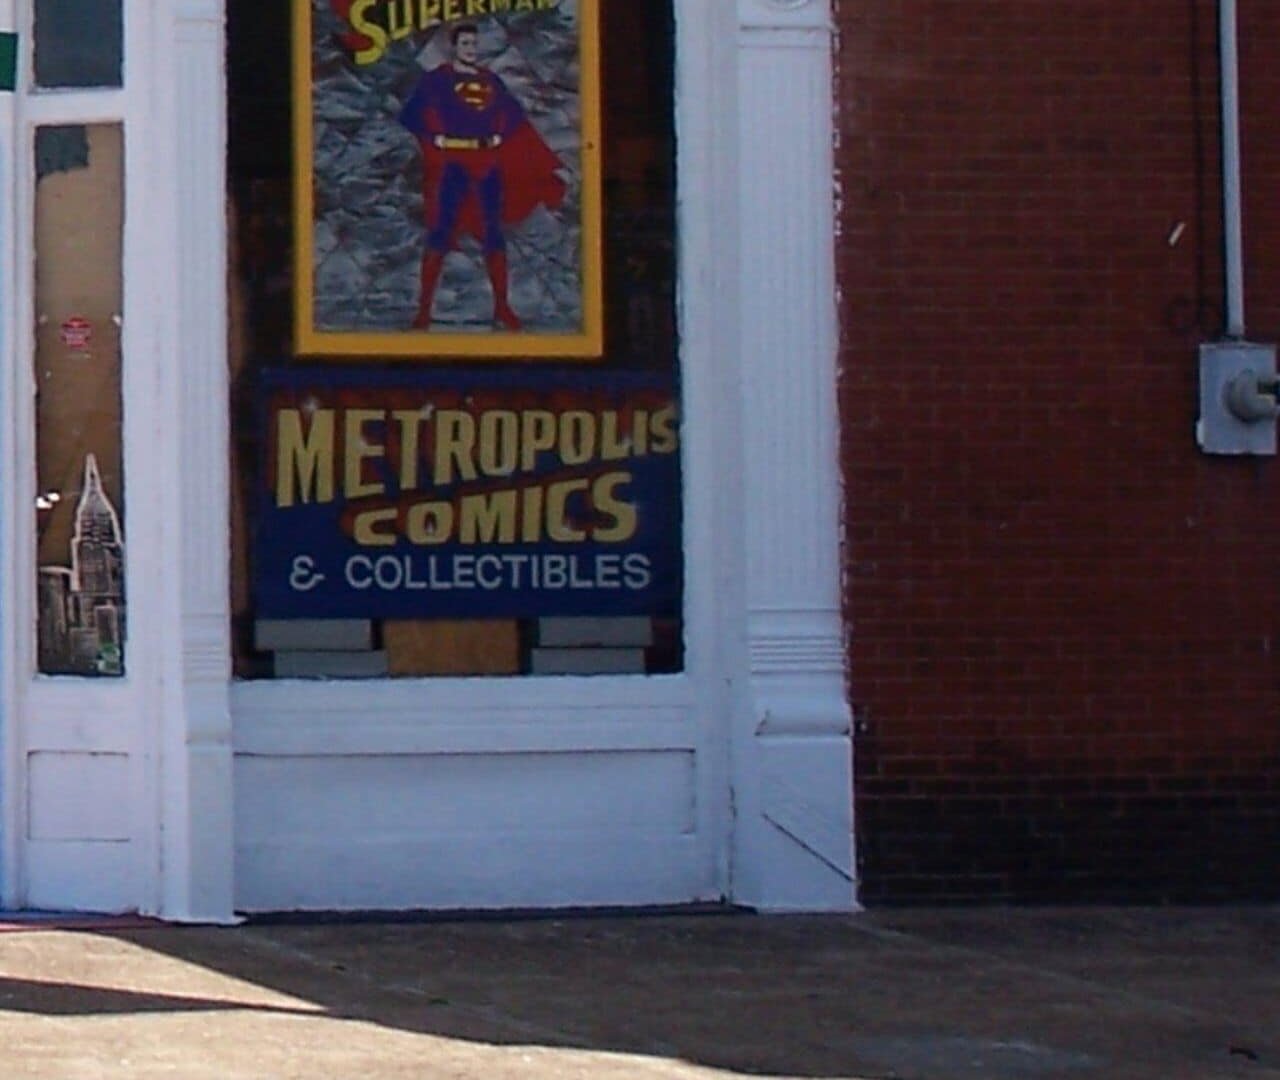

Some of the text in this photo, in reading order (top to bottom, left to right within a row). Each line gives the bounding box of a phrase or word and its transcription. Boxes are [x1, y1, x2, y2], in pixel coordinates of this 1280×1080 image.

[276, 403, 679, 508] METROPOLIS
[351, 472, 638, 545] COMICS
[289, 553, 652, 591] & COLLECTIBLES
